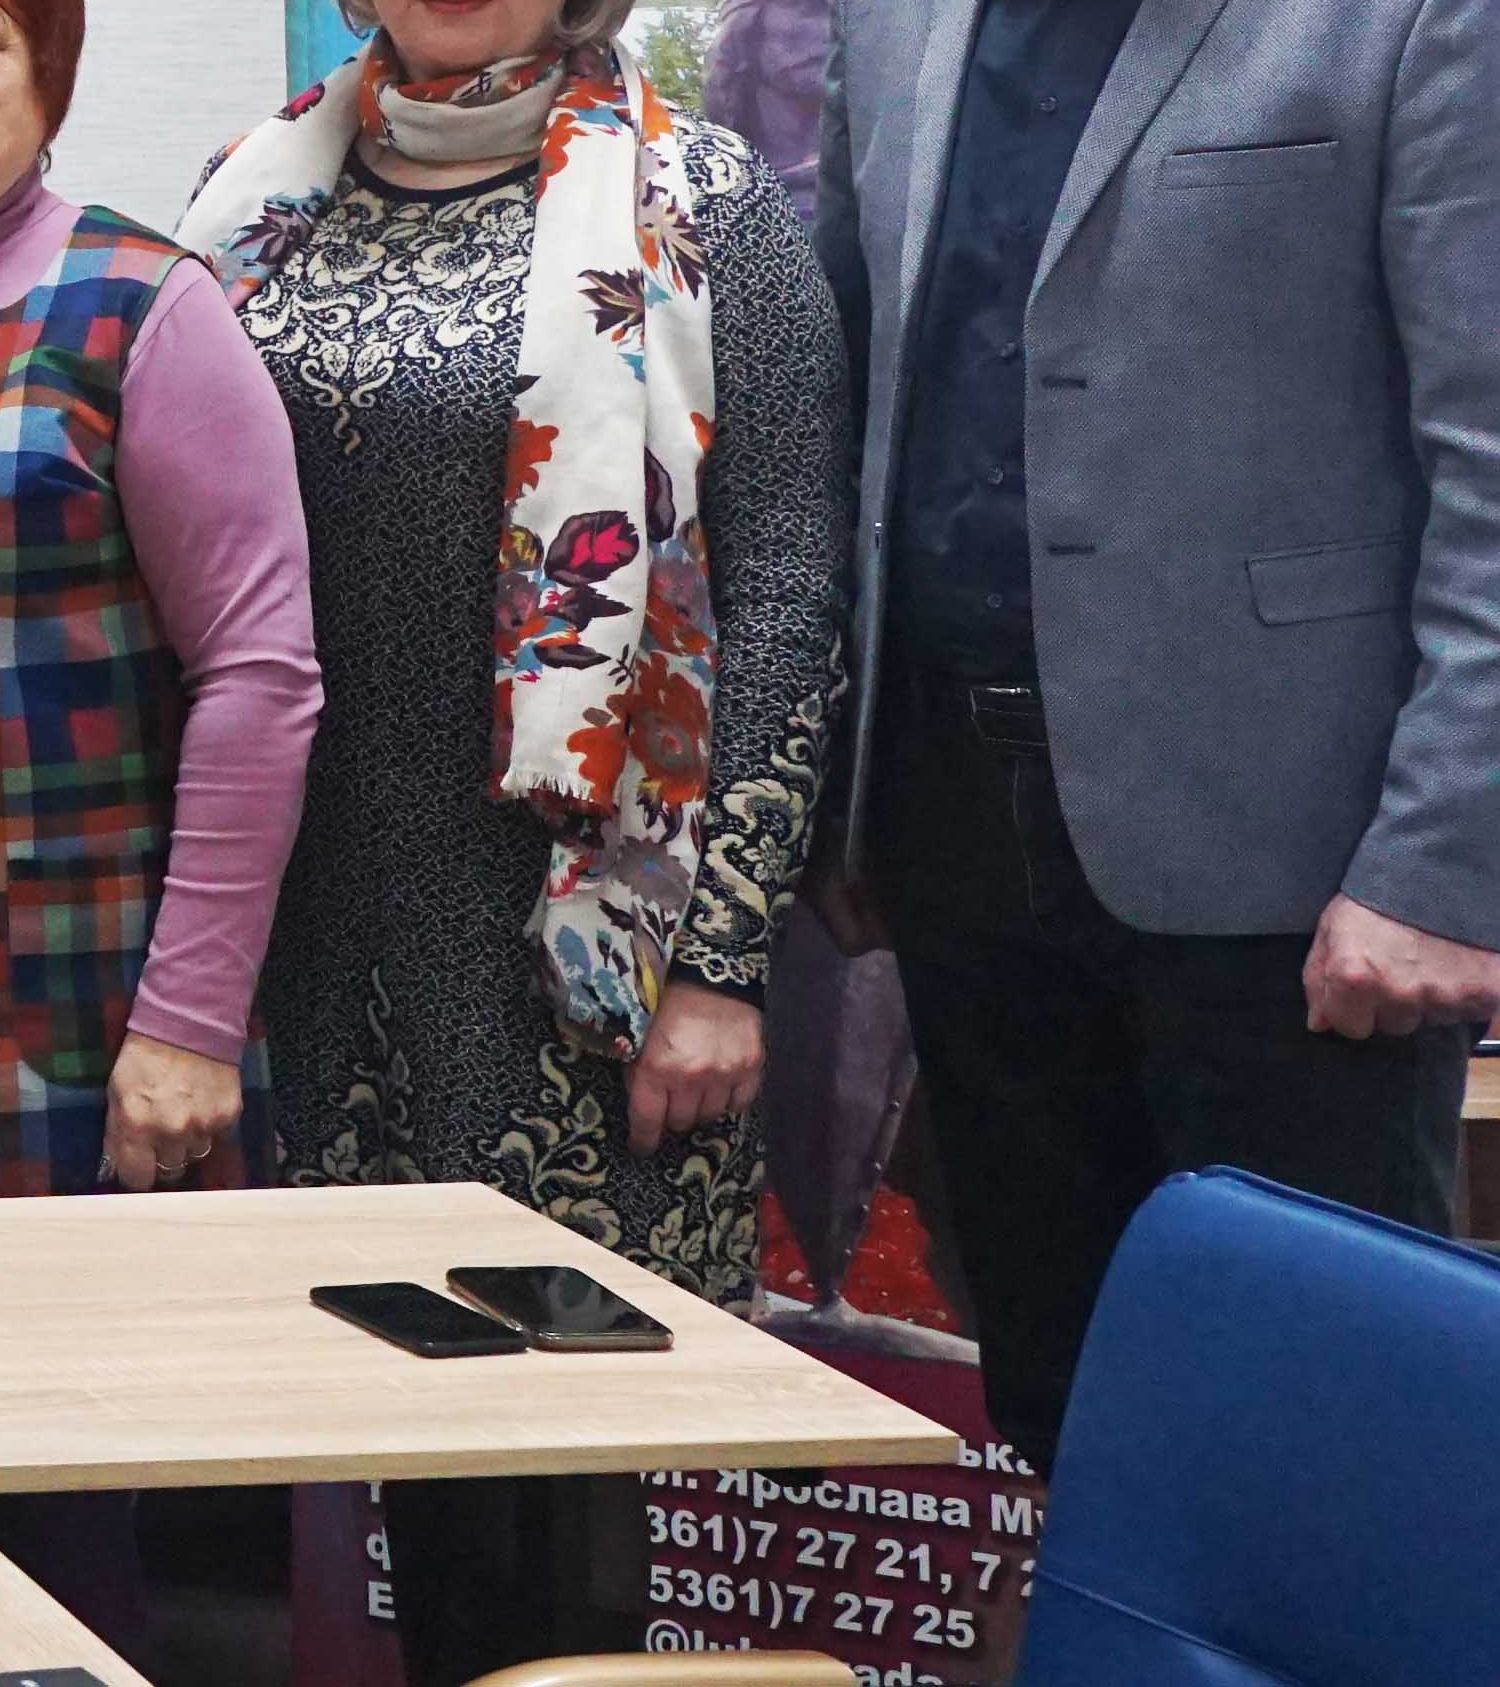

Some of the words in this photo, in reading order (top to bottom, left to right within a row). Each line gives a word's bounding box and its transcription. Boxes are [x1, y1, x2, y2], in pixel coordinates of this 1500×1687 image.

[795, 1527, 857, 1570] 27
[874, 1538, 953, 1595] 21,
[971, 1551, 1001, 1592] 7
[832, 1592, 894, 1636] 27
[912, 1604, 976, 1649] 25
